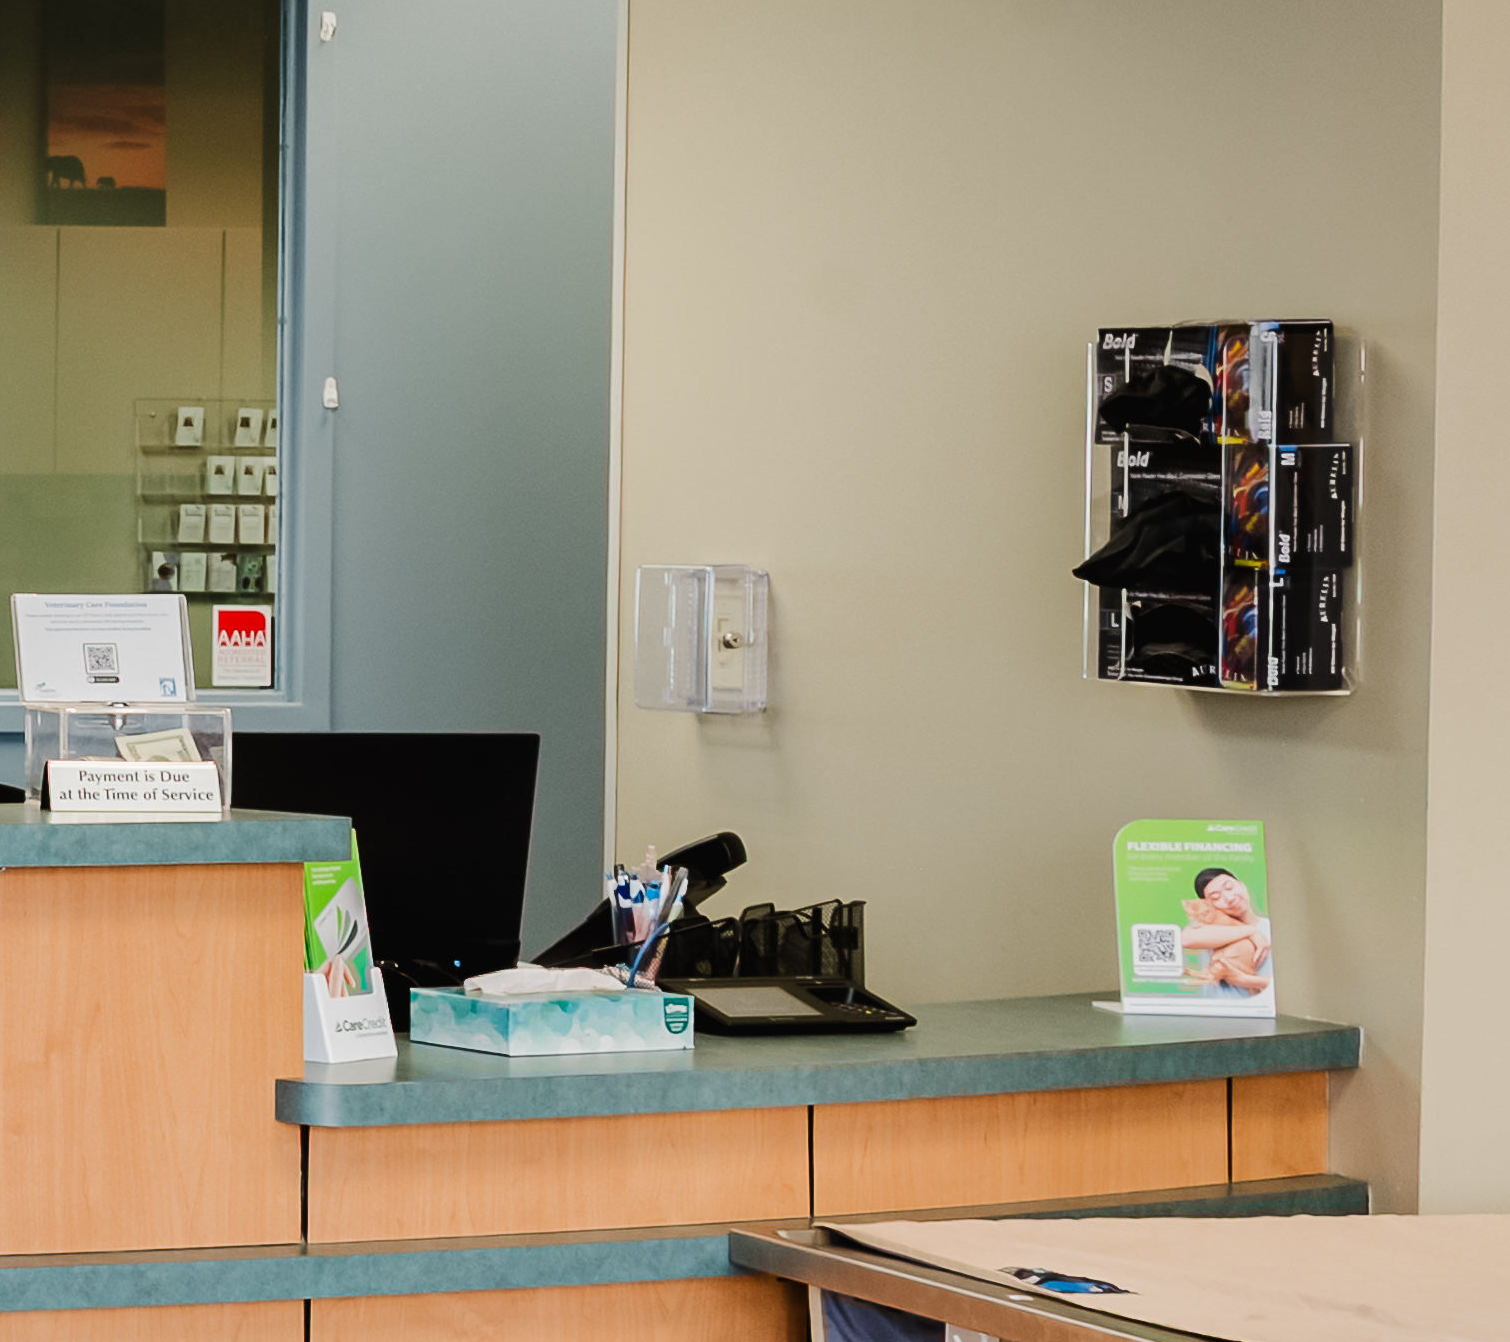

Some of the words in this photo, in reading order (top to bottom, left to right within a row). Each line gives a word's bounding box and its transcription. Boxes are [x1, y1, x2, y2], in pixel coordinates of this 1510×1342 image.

[1102, 333, 1136, 349] Bold
[1104, 377, 1113, 393] S
[1117, 451, 1150, 467] Bold
[1281, 452, 1295, 465] M
[1279, 534, 1290, 563] Bold
[1111, 612, 1119, 628] L
[218, 630, 266, 647] AAHA
[78, 770, 139, 785] Payment
[144, 770, 155, 782] is
[160, 770, 190, 782] Due
[59, 789, 73, 800] at
[78, 788, 100, 800] the
[104, 788, 138, 800] Time
[143, 788, 157, 800] of
[162, 788, 214, 801] Service
[1127, 842, 1182, 851] FLEXIBLE
[1184, 842, 1253, 852] FINANCING
[343, 1016, 387, 1032] CareCredit
